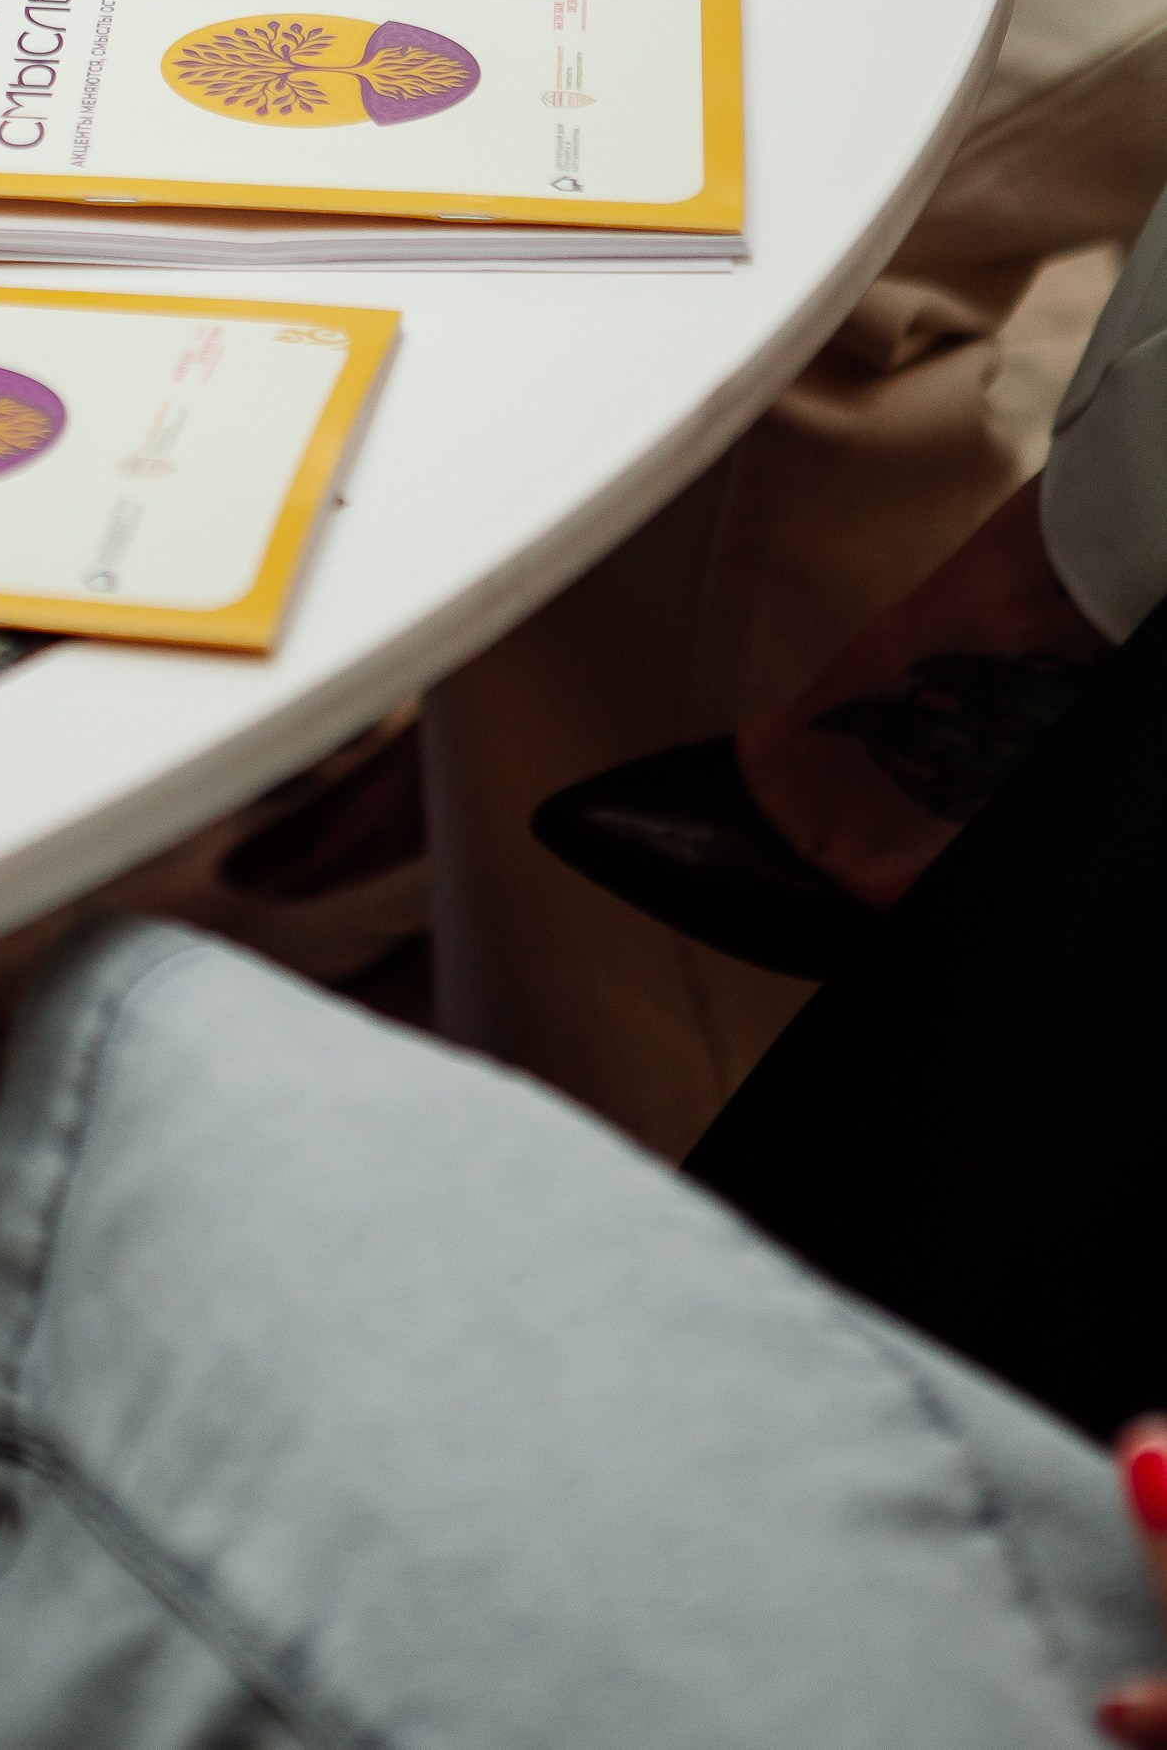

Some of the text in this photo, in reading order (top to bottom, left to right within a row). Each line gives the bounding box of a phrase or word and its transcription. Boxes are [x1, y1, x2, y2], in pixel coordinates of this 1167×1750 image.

[91, 14, 113, 58] СМЫСЛЫ
[81, 58, 108, 114] МЕНЯЮТСЯ,
[70, 114, 93, 168] АКЦЕНТЫ
